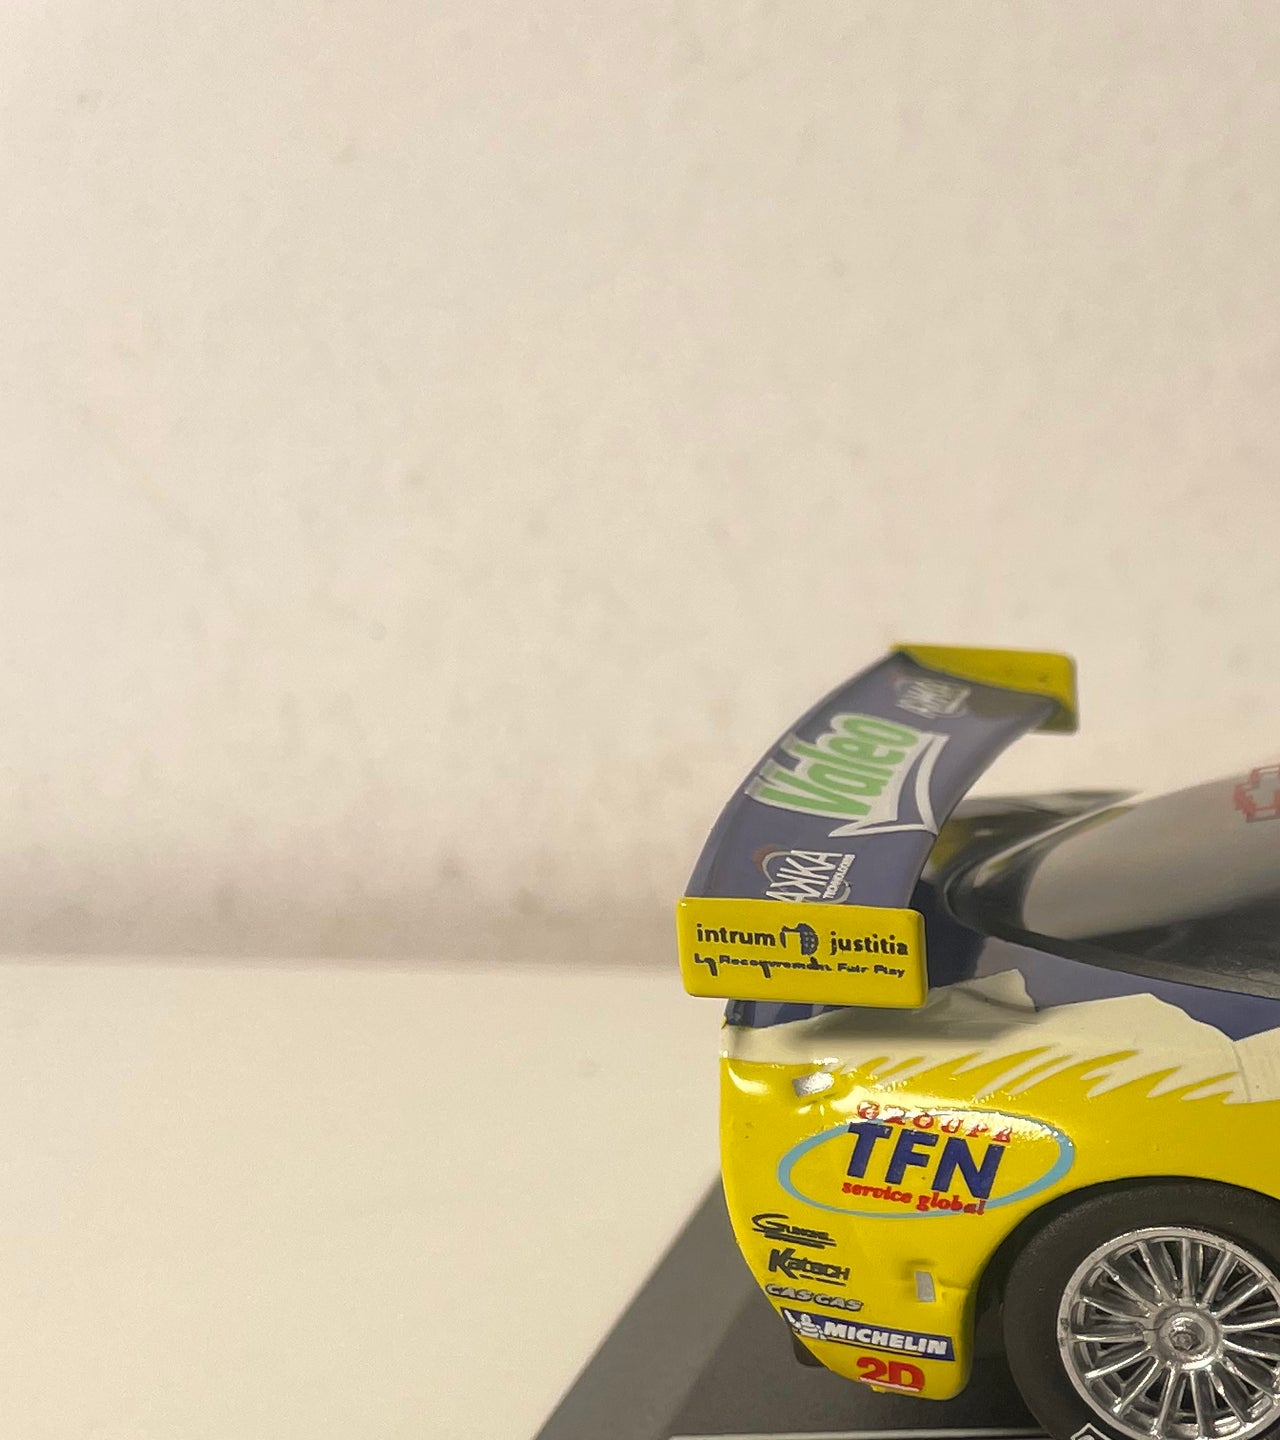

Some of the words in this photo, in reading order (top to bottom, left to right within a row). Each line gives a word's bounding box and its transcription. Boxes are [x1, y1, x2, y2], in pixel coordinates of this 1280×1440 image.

[758, 714, 920, 816] Valeo
[695, 923, 777, 948] intrum
[829, 930, 909, 956] justitia
[847, 1121, 1006, 1200] TFN
[842, 1181, 913, 1204] service
[915, 1191, 987, 1216] global
[823, 1320, 948, 1356] MICHELIN
[856, 1355, 926, 1391] 2D
